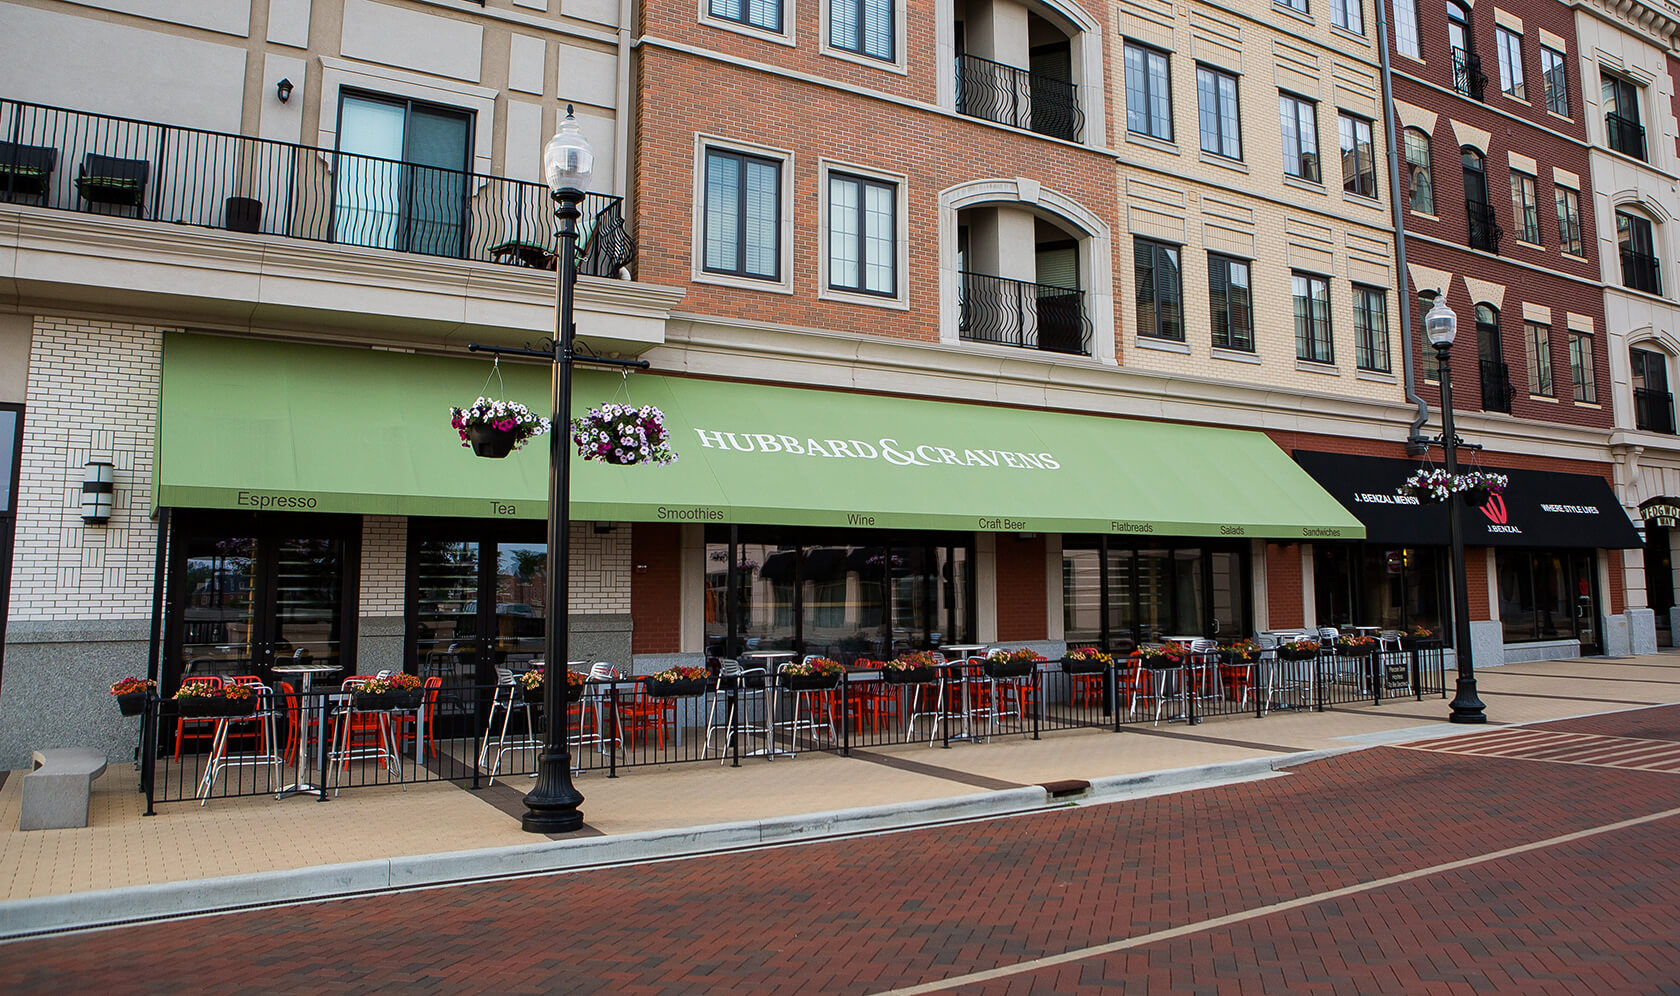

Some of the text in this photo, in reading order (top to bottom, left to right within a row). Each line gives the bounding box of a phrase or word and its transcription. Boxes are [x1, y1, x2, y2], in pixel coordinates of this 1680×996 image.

[237, 491, 317, 510] Espresso
[1354, 493, 1420, 505] J. BENZAL MENS
[489, 501, 517, 515] Tea
[657, 506, 724, 521] Smoothies
[1540, 503, 1600, 514] WHERE STYLE LIVES
[1640, 505, 1680, 520] WEDGWO
[847, 513, 875, 526] Wine
[978, 517, 1026, 530] Craft Beer
[1111, 521, 1154, 533] Flatbreads
[1220, 525, 1245, 536] Salads
[1302, 527, 1341, 537] Sandwiches
